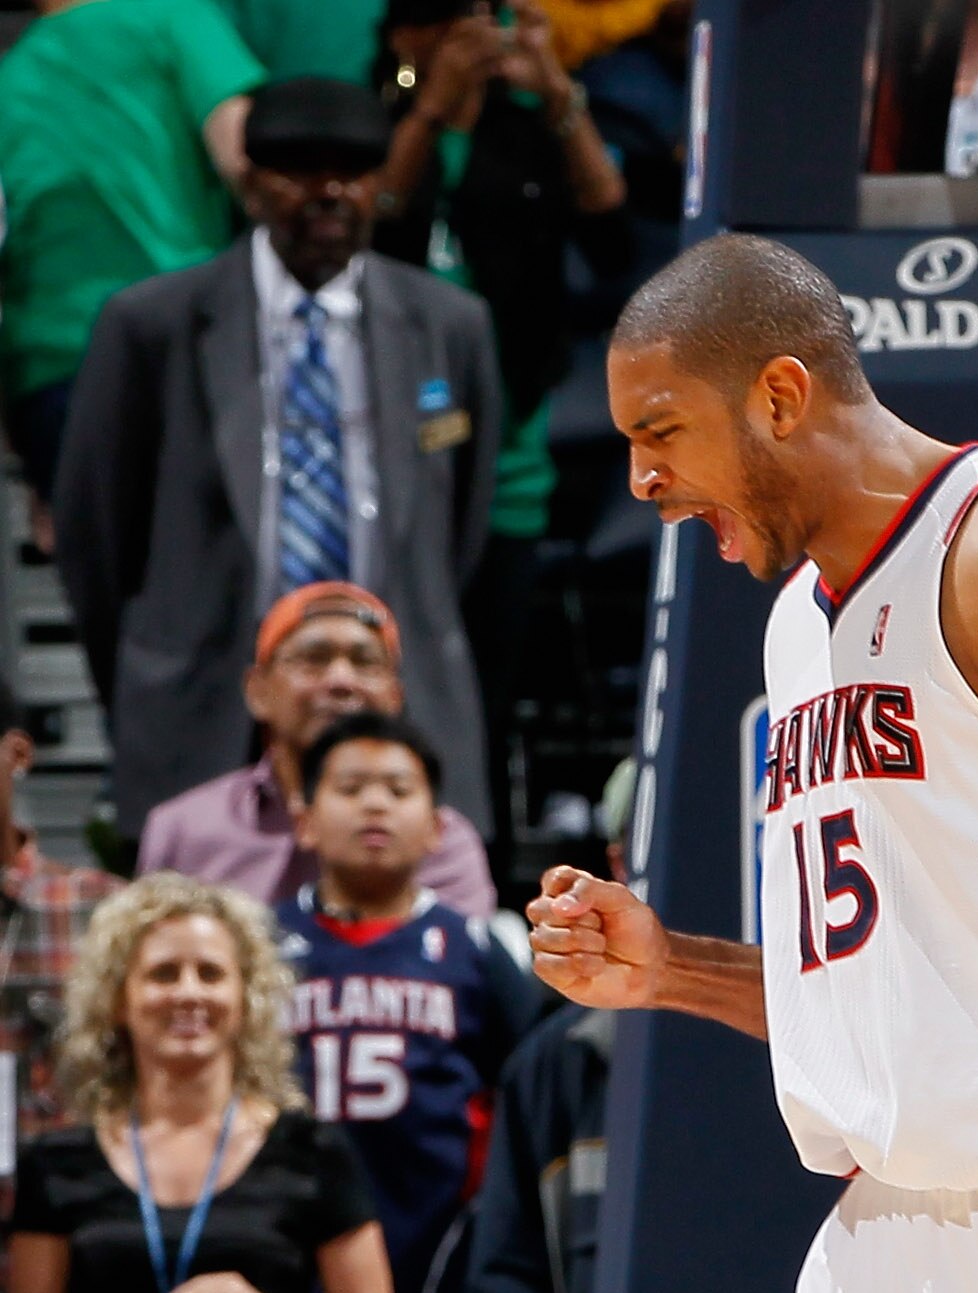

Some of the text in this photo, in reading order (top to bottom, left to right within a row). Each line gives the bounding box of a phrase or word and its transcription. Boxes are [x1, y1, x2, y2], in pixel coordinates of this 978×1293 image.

[765, 683, 927, 814] HAWKS
[792, 808, 880, 974] 15
[311, 1031, 410, 1124] 15
